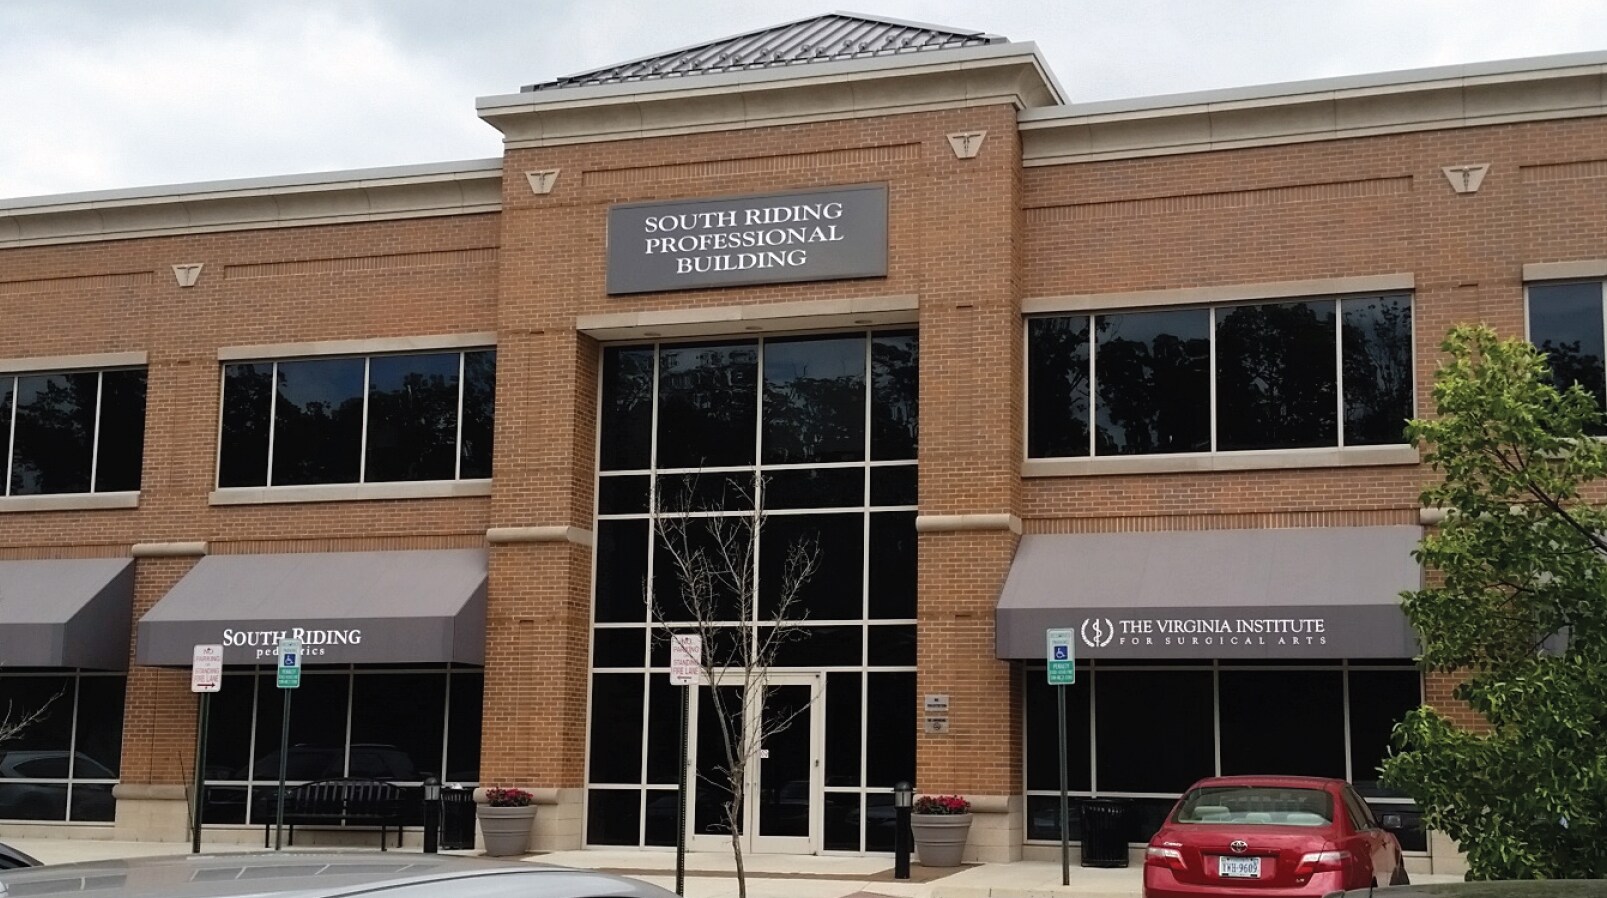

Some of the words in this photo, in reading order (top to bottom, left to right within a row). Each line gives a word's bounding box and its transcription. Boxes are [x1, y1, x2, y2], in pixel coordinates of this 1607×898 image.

[645, 209, 738, 233] SOUTH
[744, 202, 844, 226] RIDING
[645, 225, 845, 255] PROFESSIONAL
[676, 249, 808, 274] BUILDING
[1119, 620, 1153, 633] THE
[1156, 619, 1232, 633] VIRGINIA
[1236, 619, 1325, 633] INSTITUTE
[223, 628, 287, 646] SOUTH
[292, 627, 362, 645] RIDING
[1119, 637, 1154, 645] FOR
[1165, 637, 1265, 645] SURGICAL
[1278, 636, 1327, 645] ARTS
[256, 646, 325, 659] pedrics
